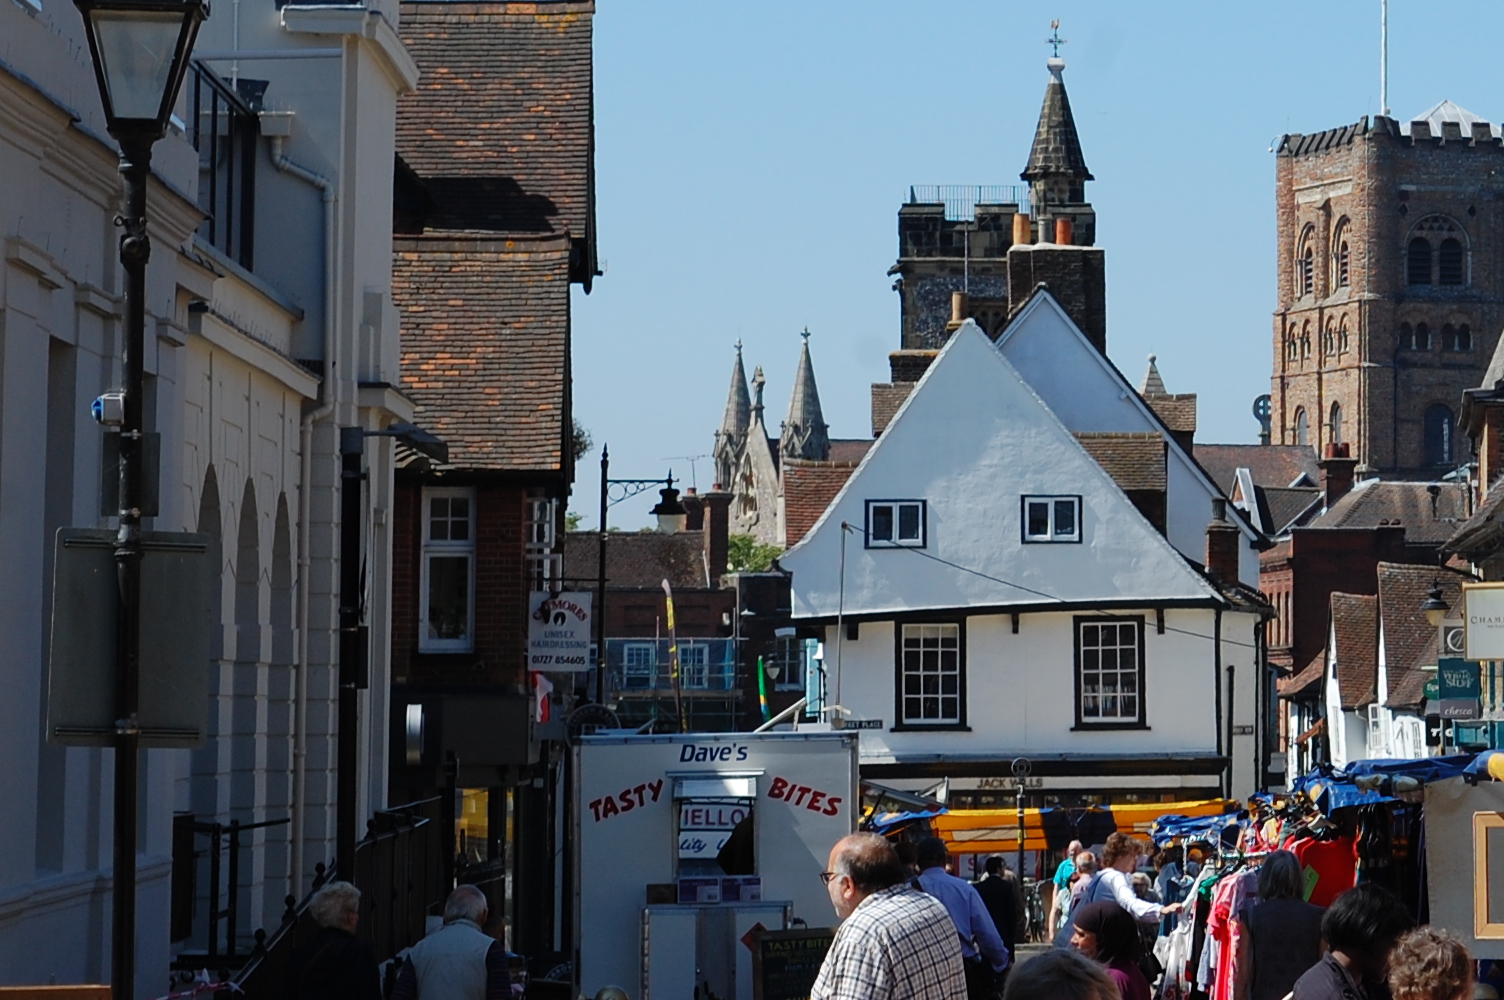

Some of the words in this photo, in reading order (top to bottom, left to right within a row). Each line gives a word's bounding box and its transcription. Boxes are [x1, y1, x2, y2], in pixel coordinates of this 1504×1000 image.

[532, 599, 588, 622] CTMORES
[544, 630, 575, 639] UNISEX
[531, 640, 588, 649] HAIRDRESSING
[532, 655, 553, 665] 01727
[680, 743, 748, 763] Dave's
[977, 778, 1005, 788] JACK
[1009, 778, 1043, 788] WLLS
[589, 778, 664, 823] TASTY
[767, 776, 843, 817] BITES
